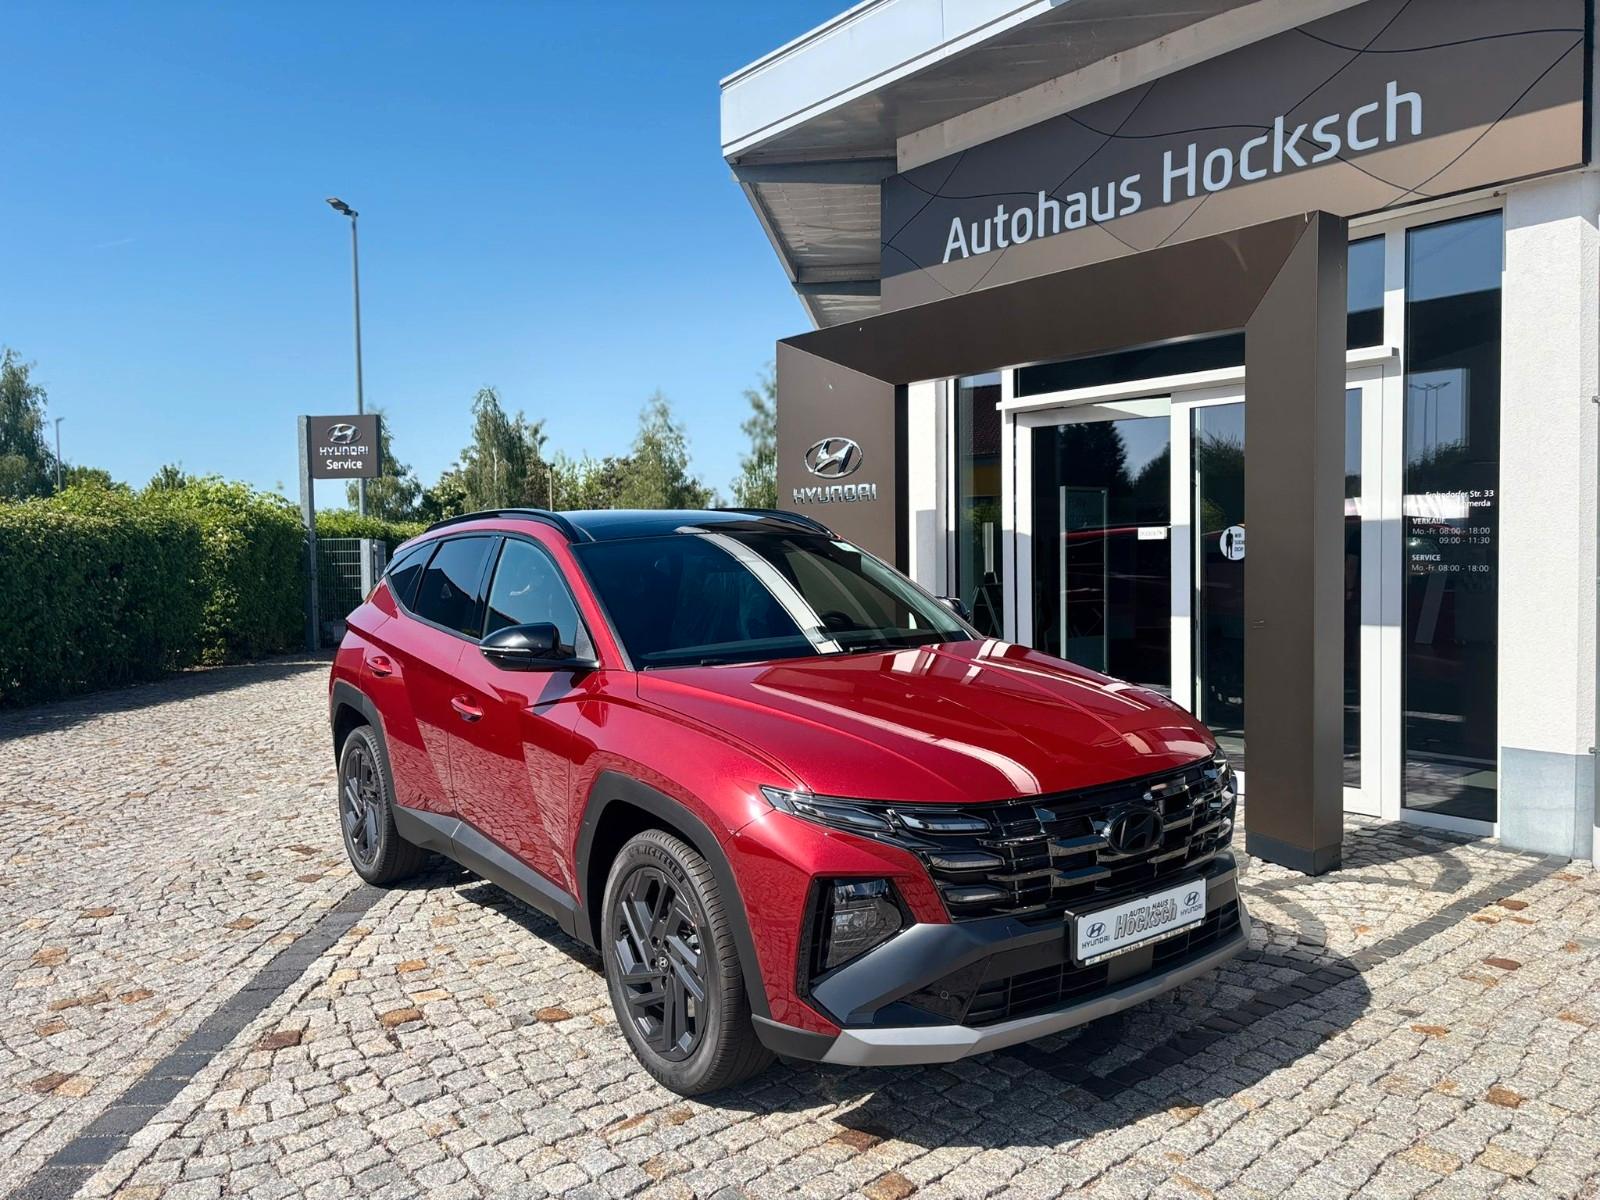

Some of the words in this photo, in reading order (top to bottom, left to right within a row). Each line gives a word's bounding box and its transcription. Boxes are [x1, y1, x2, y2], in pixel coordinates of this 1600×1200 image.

[941, 173, 1142, 264] Autohaus
[1162, 80, 1423, 205] Hocksch
[319, 445, 369, 456] HYUNDAI
[326, 459, 363, 470] Service
[793, 483, 877, 504] HYUNDAI
[1469, 490, 1482, 498] Str.
[1484, 489, 1495, 497] 33
[1439, 527, 1461, 535] 08:00
[1468, 527, 1491, 535] 18:00
[1468, 536, 1490, 544] 11:30
[1438, 564, 1460, 572] 08:00
[1467, 564, 1490, 572] 18:00
[1128, 907, 1146, 918] AUTO
[1152, 899, 1169, 909] HAUS
[1180, 903, 1203, 917] HYUNDAI
[1113, 898, 1178, 940] Hocksch
[1081, 934, 1111, 949] HYUNDAI
